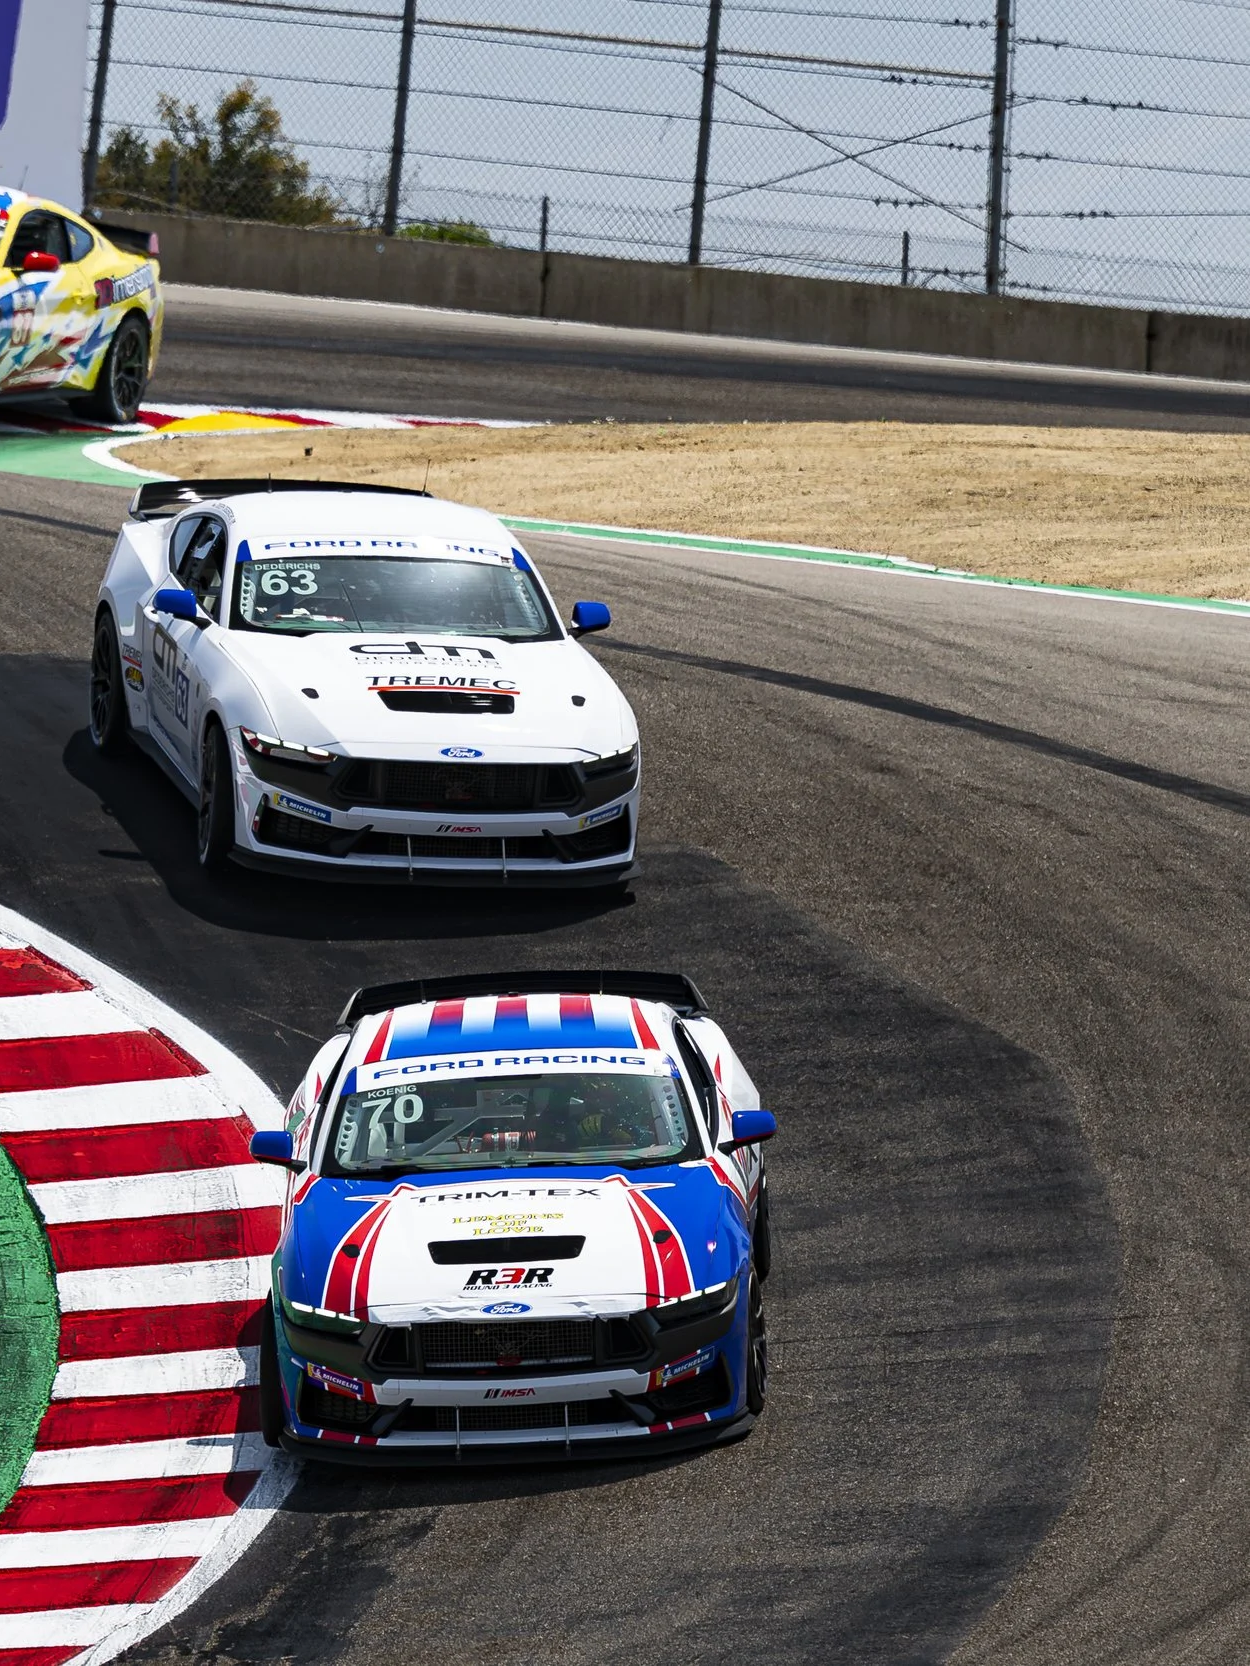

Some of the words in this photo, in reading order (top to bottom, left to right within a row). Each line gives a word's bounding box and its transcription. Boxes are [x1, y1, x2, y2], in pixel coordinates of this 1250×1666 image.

[265, 541, 362, 550] FORD
[254, 562, 321, 571] DEDERICHS
[260, 570, 318, 596] 63
[366, 676, 517, 690] TREMEC
[177, 672, 189, 723] 63
[289, 801, 327, 819] MICHELIN
[374, 1060, 484, 1080] FORD
[494, 1055, 646, 1068] RACING
[367, 1084, 417, 1099] KOENIG
[362, 1093, 424, 1130] 70
[410, 1188, 601, 1204] TRIM-TEX
[452, 1213, 564, 1225] LEMONS
[490, 1219, 528, 1227] OF
[472, 1226, 545, 1236] LOVE
[465, 1268, 555, 1286] R3R
[673, 1353, 710, 1374] MICHELIN
[322, 1373, 360, 1391] MICHELIN
[500, 1388, 537, 1398] IMSA
